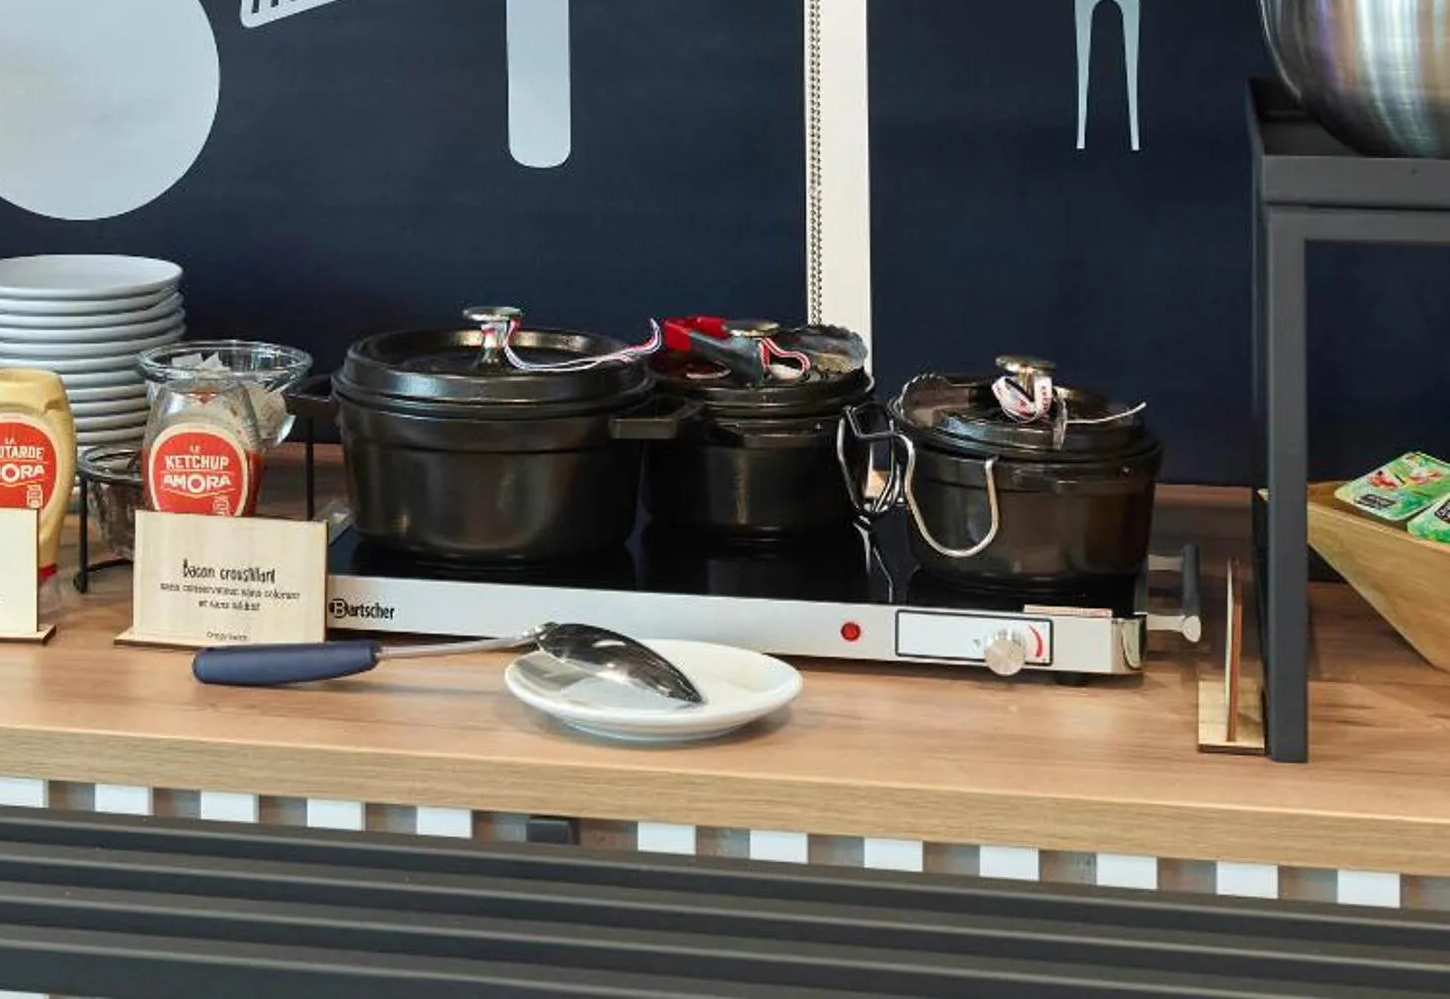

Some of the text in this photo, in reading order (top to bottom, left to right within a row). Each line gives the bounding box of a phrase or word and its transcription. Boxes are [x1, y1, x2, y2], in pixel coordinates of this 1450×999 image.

[165, 455, 230, 470] KETCHUP
[163, 473, 231, 493] AMORA
[329, 598, 395, 619] Bartscher
